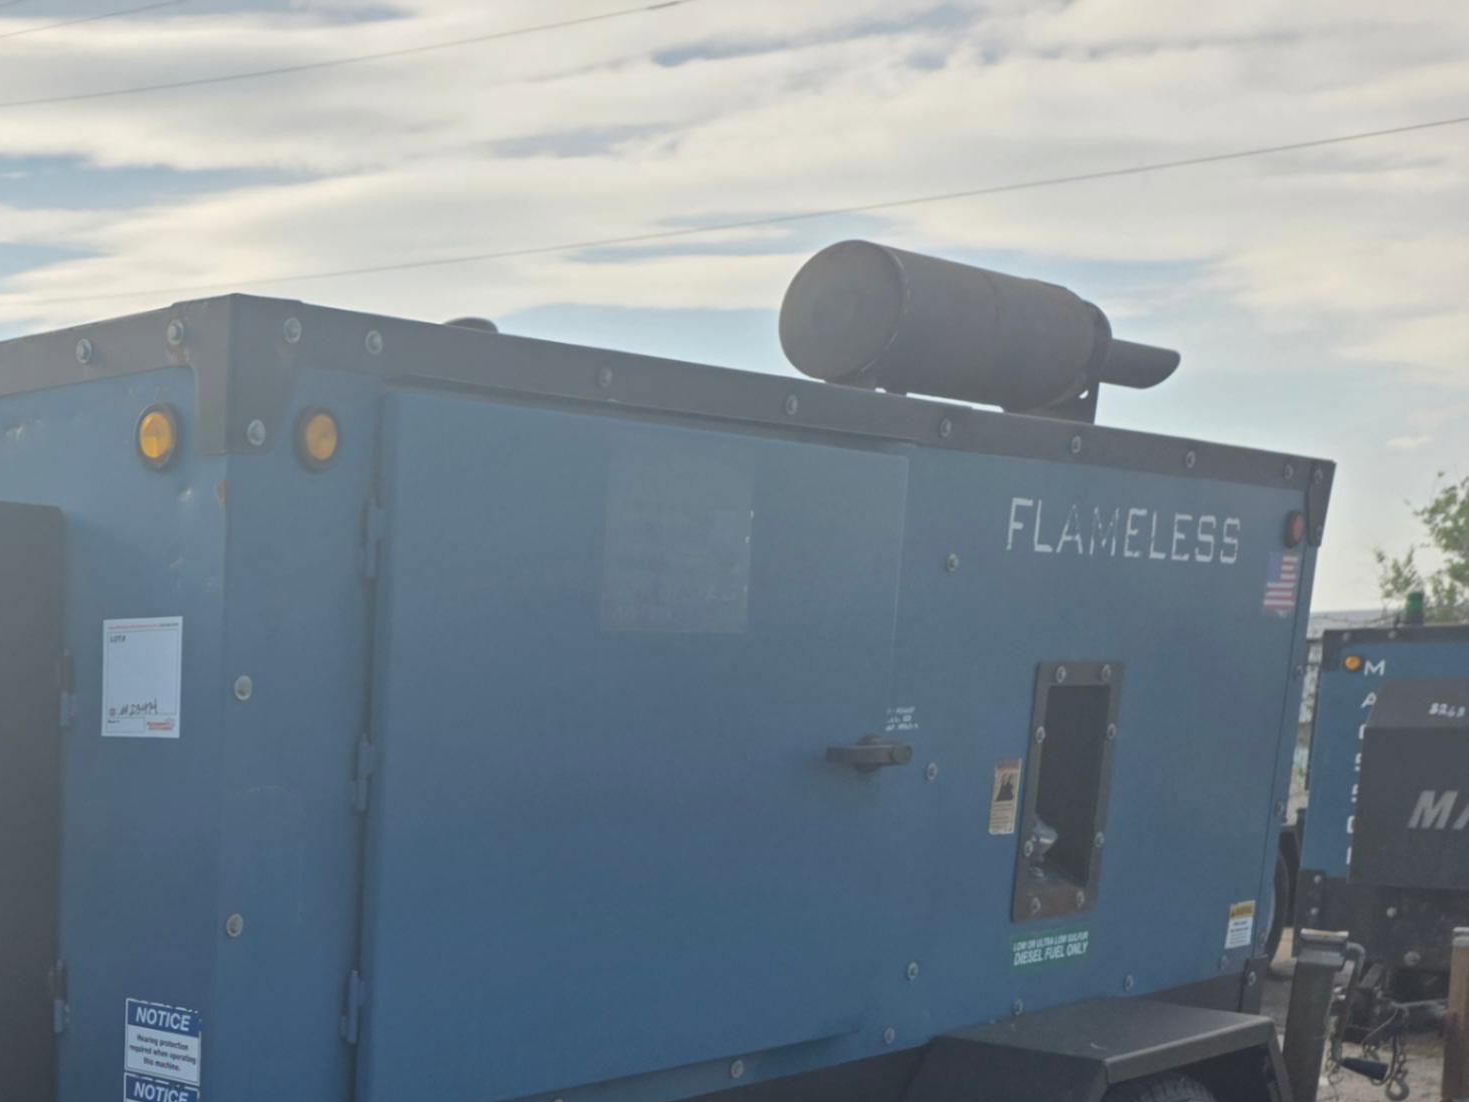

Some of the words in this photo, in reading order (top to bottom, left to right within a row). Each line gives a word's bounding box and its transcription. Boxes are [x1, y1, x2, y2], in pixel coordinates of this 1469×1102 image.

[1006, 497, 1241, 564] FLAMELESS
[1014, 949, 1043, 966] DIESEL
[1044, 945, 1064, 960] FUEL
[1066, 940, 1089, 957] ONLY
[136, 1006, 191, 1031] NOTICE
